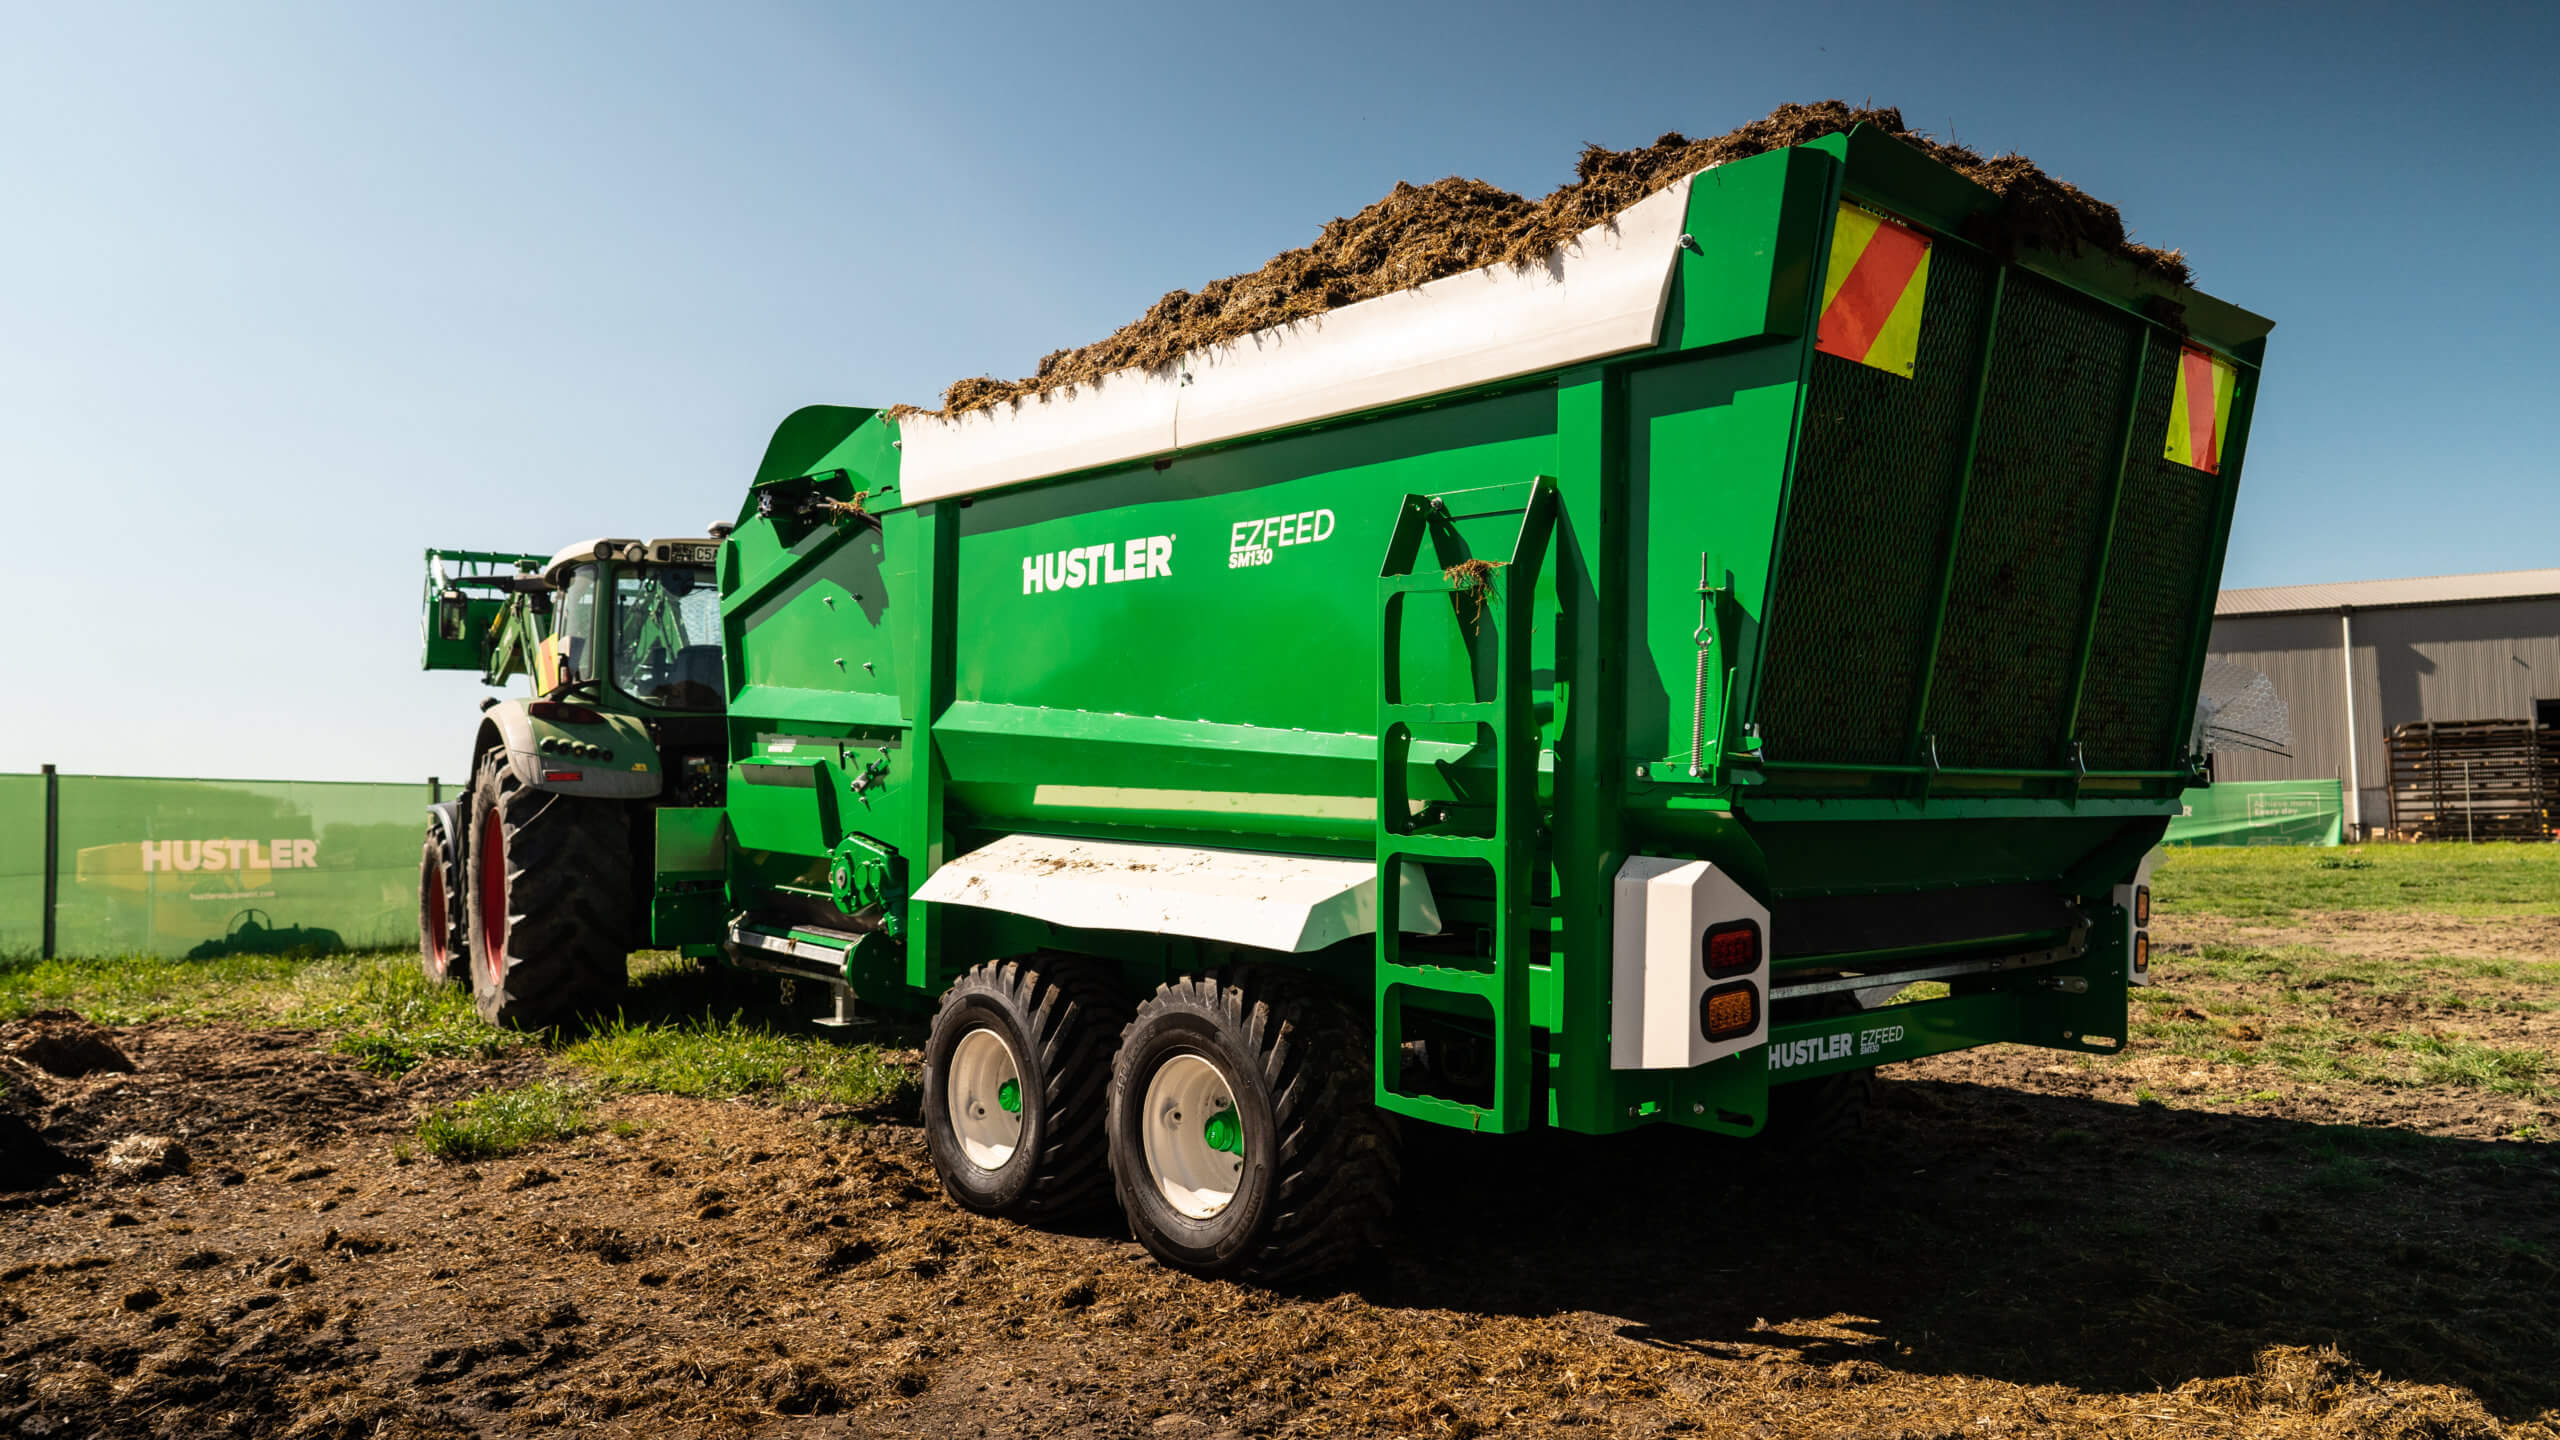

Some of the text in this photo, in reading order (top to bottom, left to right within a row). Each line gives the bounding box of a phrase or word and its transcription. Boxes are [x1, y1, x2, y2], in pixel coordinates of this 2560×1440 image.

[1230, 508, 1335, 553] EZFEED
[1022, 535, 1173, 595] HUSTLER
[1228, 548, 1273, 568] SM130
[141, 839, 318, 872] HUSTLER
[1768, 1025, 1904, 1070] HUSTLER EZFEED
